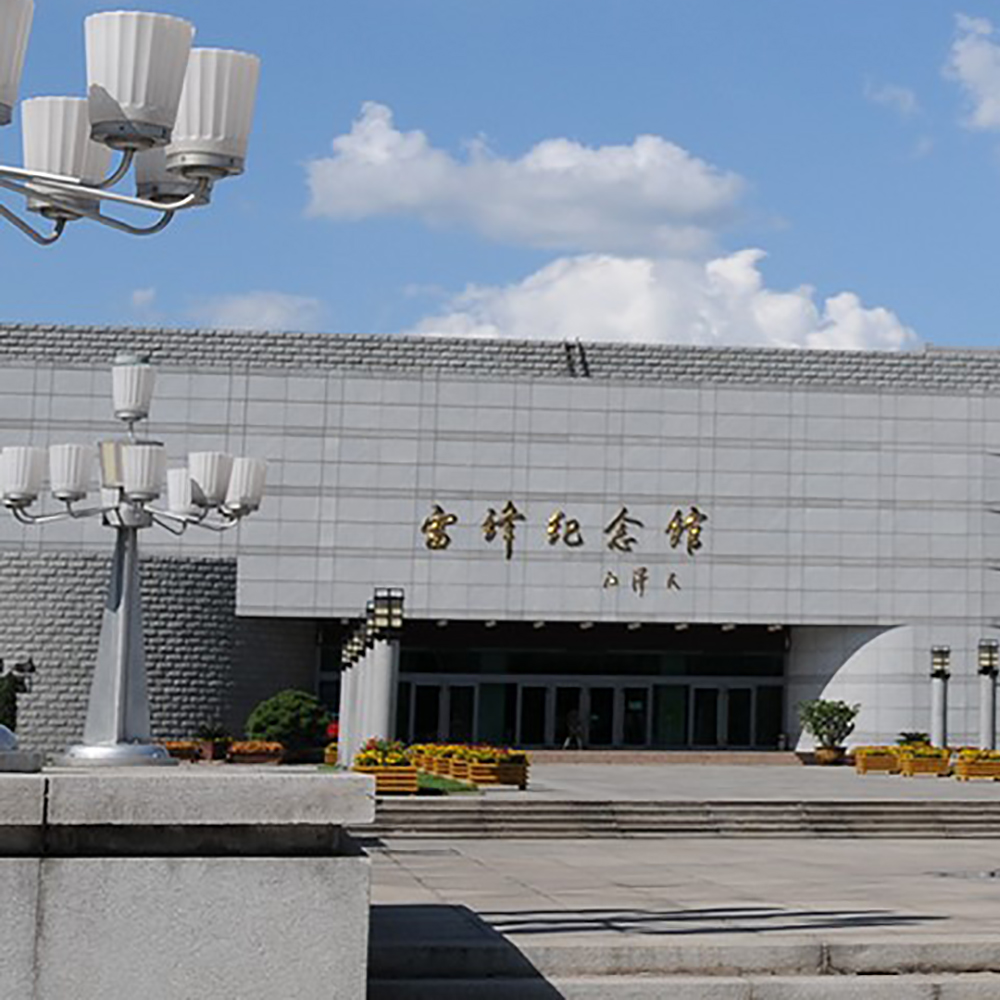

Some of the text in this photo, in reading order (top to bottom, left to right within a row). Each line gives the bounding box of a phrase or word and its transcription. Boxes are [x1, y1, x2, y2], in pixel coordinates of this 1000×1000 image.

[421, 500, 708, 560] 雷锋纪念馆
